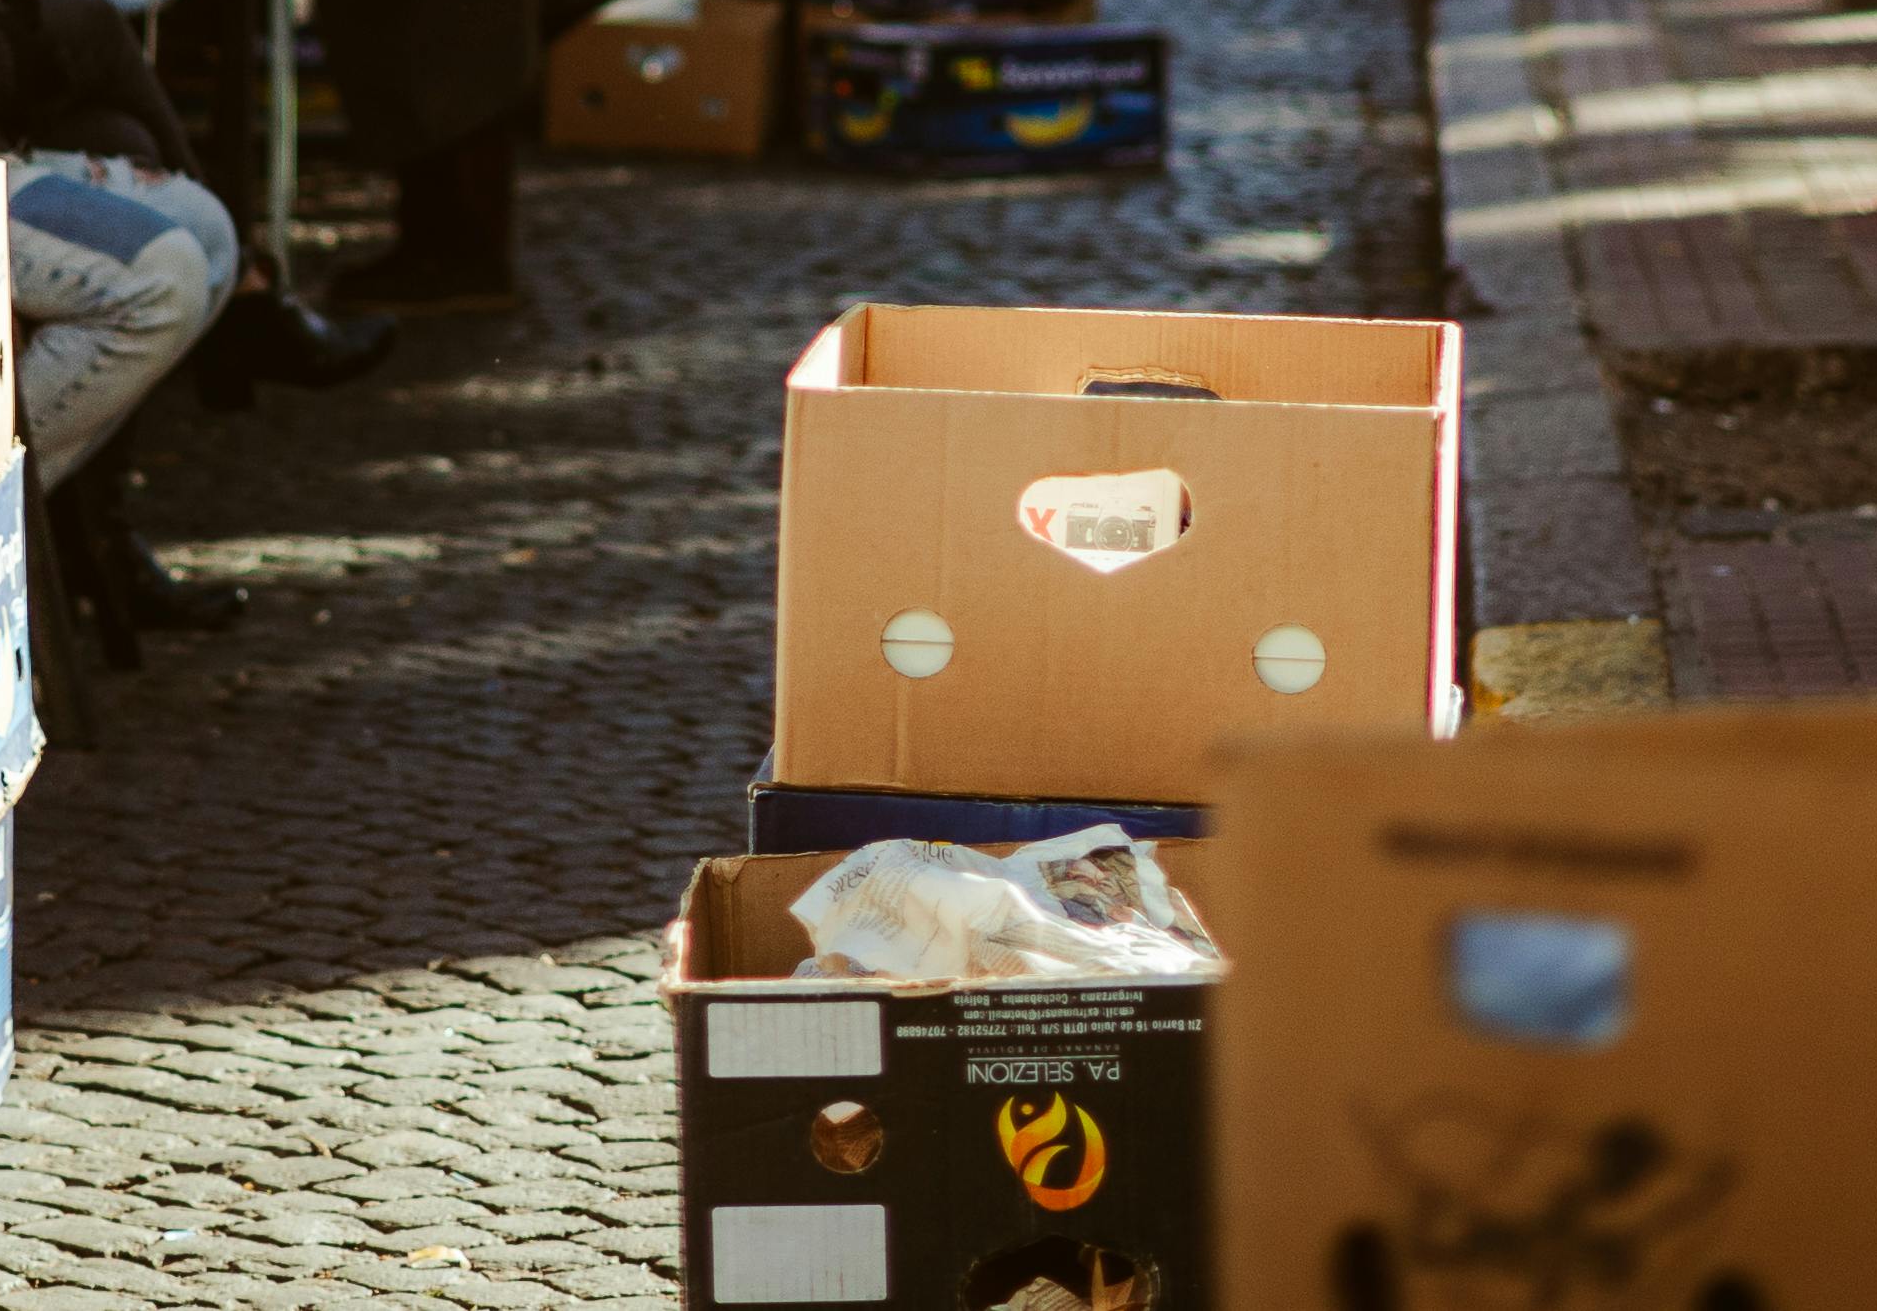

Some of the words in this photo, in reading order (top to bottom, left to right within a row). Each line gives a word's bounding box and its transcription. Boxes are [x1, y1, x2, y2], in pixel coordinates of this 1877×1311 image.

[954, 994, 990, 1006] Bolivia
[1002, 992, 1069, 1005] Cochabamba
[1121, 1020, 1133, 1032] de
[1152, 1019, 1185, 1031] Barrio
[967, 1061, 1074, 1084] SELEZIONI
[1082, 1061, 1120, 1080] P.A.
